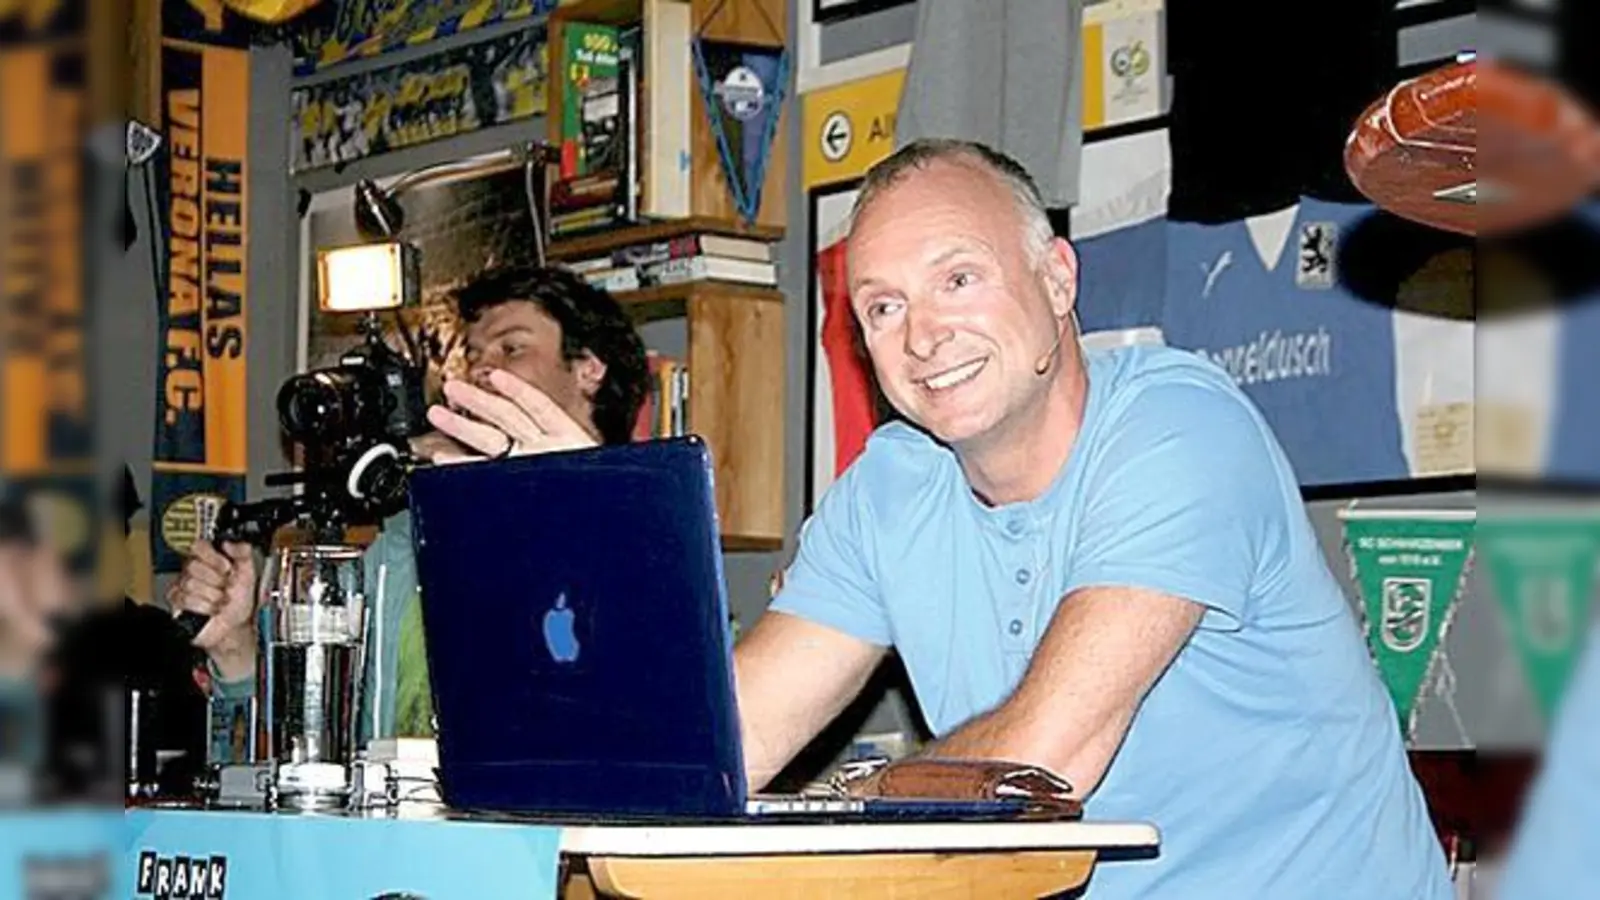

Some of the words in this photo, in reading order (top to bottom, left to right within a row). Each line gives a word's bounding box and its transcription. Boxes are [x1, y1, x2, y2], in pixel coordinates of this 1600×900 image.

[168, 90, 200, 317] VERONA
[206, 156, 241, 359] HELLAS
[139, 856, 225, 896] FRANK
